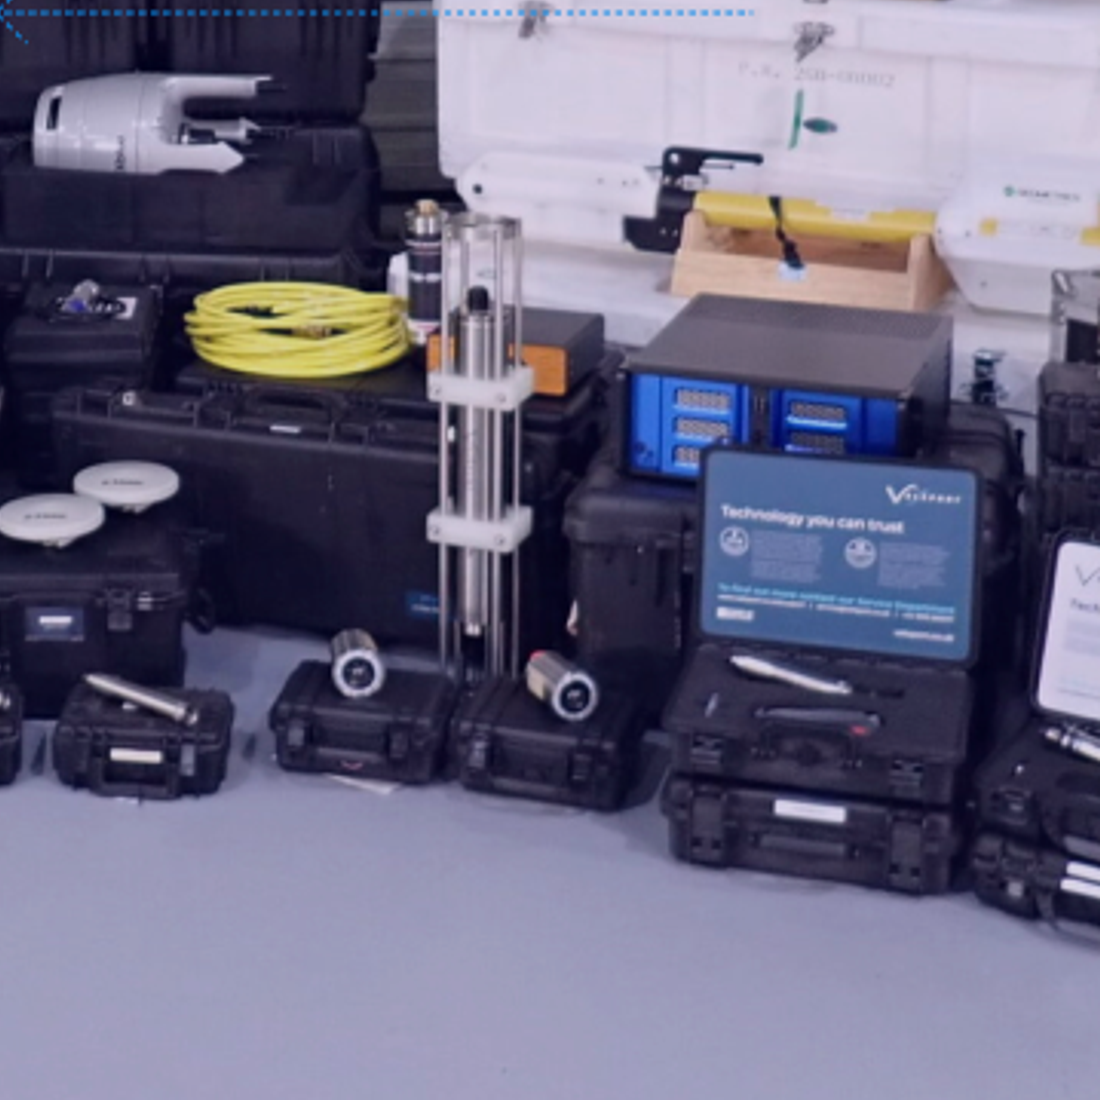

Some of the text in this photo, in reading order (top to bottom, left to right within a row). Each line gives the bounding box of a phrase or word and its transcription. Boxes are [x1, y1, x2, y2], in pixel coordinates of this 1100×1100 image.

[720, 503, 905, 534] Technology you can trust
